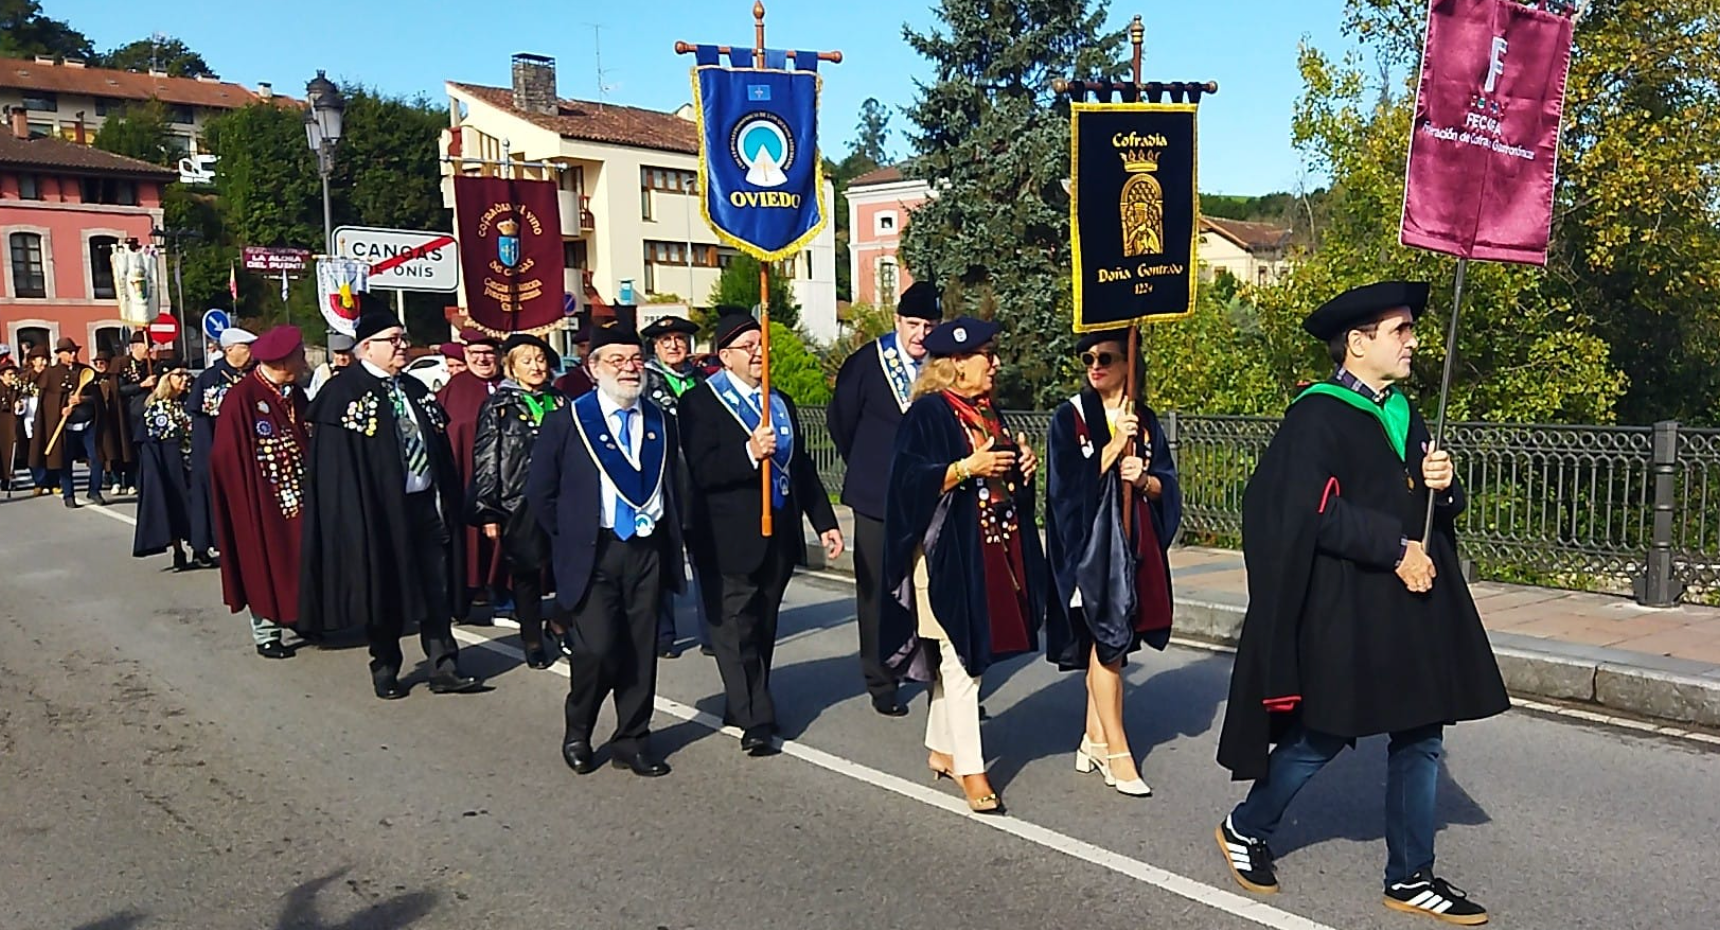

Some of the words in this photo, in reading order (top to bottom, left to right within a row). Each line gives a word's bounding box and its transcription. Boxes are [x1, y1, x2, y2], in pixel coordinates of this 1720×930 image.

[730, 191, 800, 209] OVIEDO
[352, 242, 443, 261] CANGAS
[246, 261, 267, 269] DEL
[393, 264, 434, 278] ONÍS
